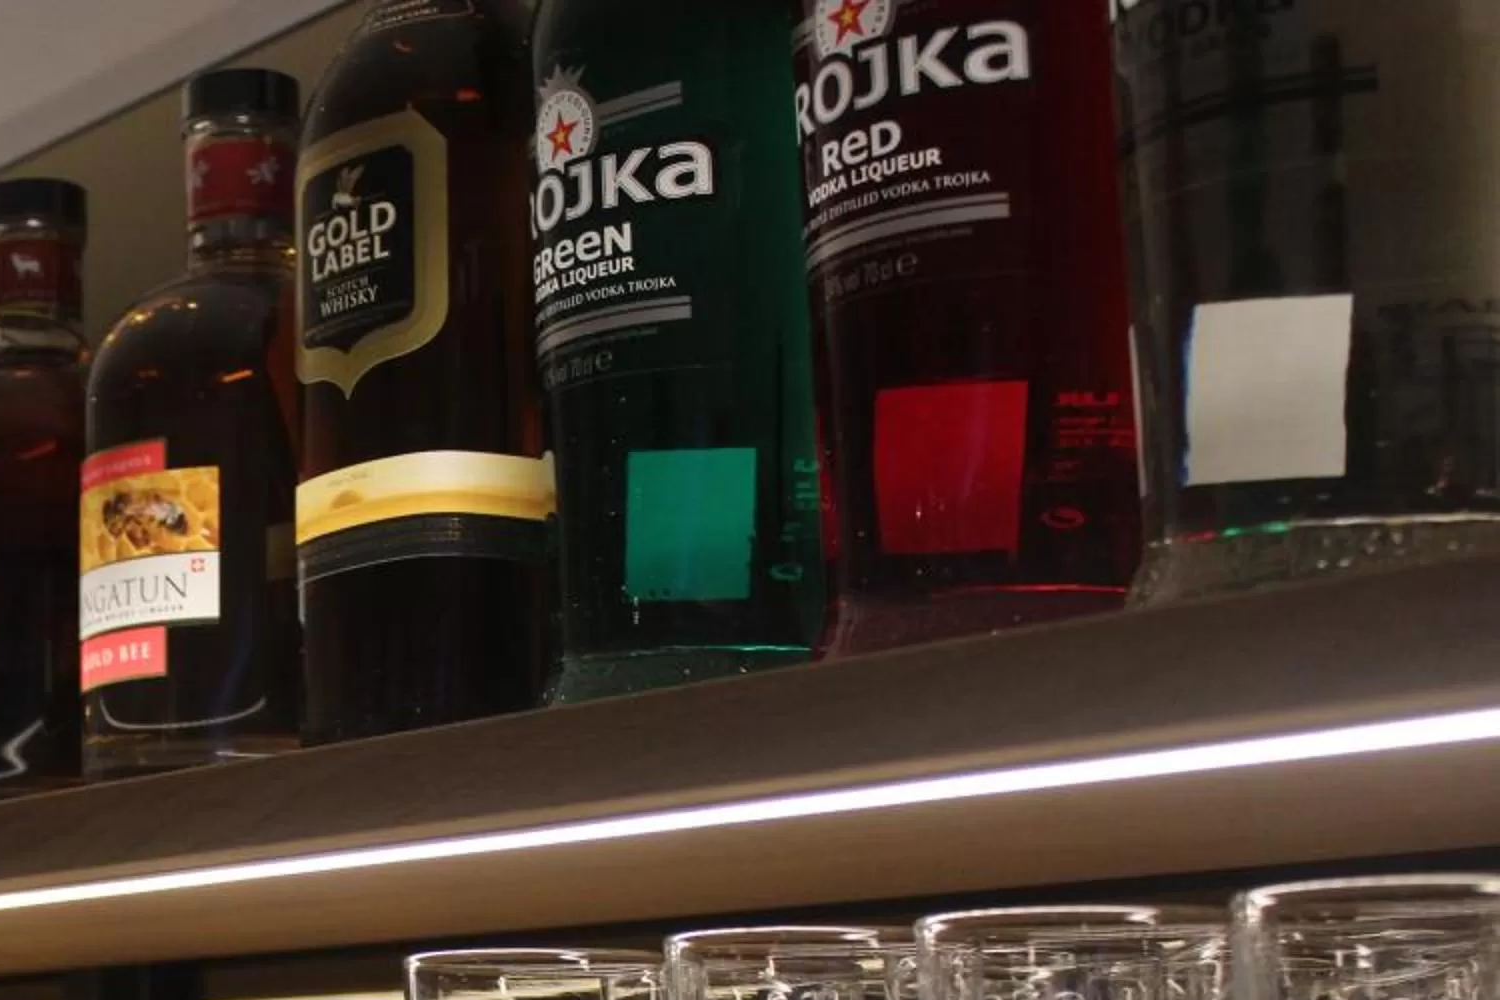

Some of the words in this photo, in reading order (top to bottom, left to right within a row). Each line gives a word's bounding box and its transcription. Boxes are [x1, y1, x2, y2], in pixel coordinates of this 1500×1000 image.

[851, 147, 943, 186] LIQUEUR
[529, 141, 714, 240] OJKa
[881, 179, 930, 200] VODKA
[933, 170, 992, 189] TROJKA
[307, 200, 397, 257] GOLD
[311, 235, 391, 283] LABEL
[561, 256, 636, 288] LIQUEUR
[320, 285, 379, 317] WHISKY
[326, 274, 371, 298] SCOTCH
[585, 284, 625, 301] VODKA
[627, 276, 677, 294] TROJKA
[119, 641, 151, 663] BEE
